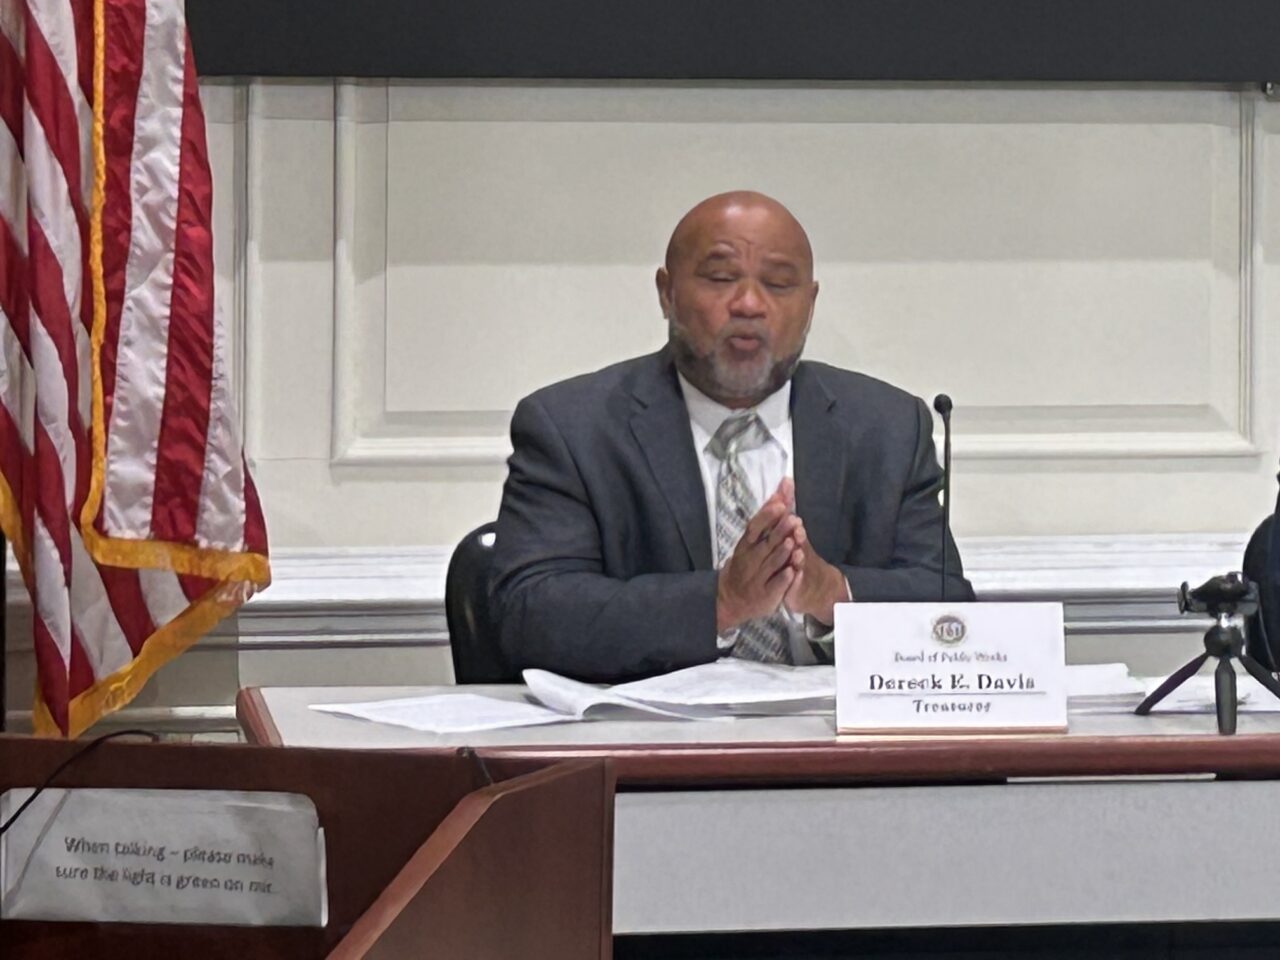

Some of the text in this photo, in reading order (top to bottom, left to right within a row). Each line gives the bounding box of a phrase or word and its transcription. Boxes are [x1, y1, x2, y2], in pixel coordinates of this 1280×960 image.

[978, 673, 1035, 690] Davis
[64, 837, 110, 854] When
[115, 840, 166, 862] talking
[183, 848, 232, 865] please
[237, 852, 275, 869] make
[56, 866, 89, 880] sure
[93, 866, 119, 882] the
[122, 867, 155, 887] light
[175, 874, 221, 890] green
[223, 878, 244, 892] on
